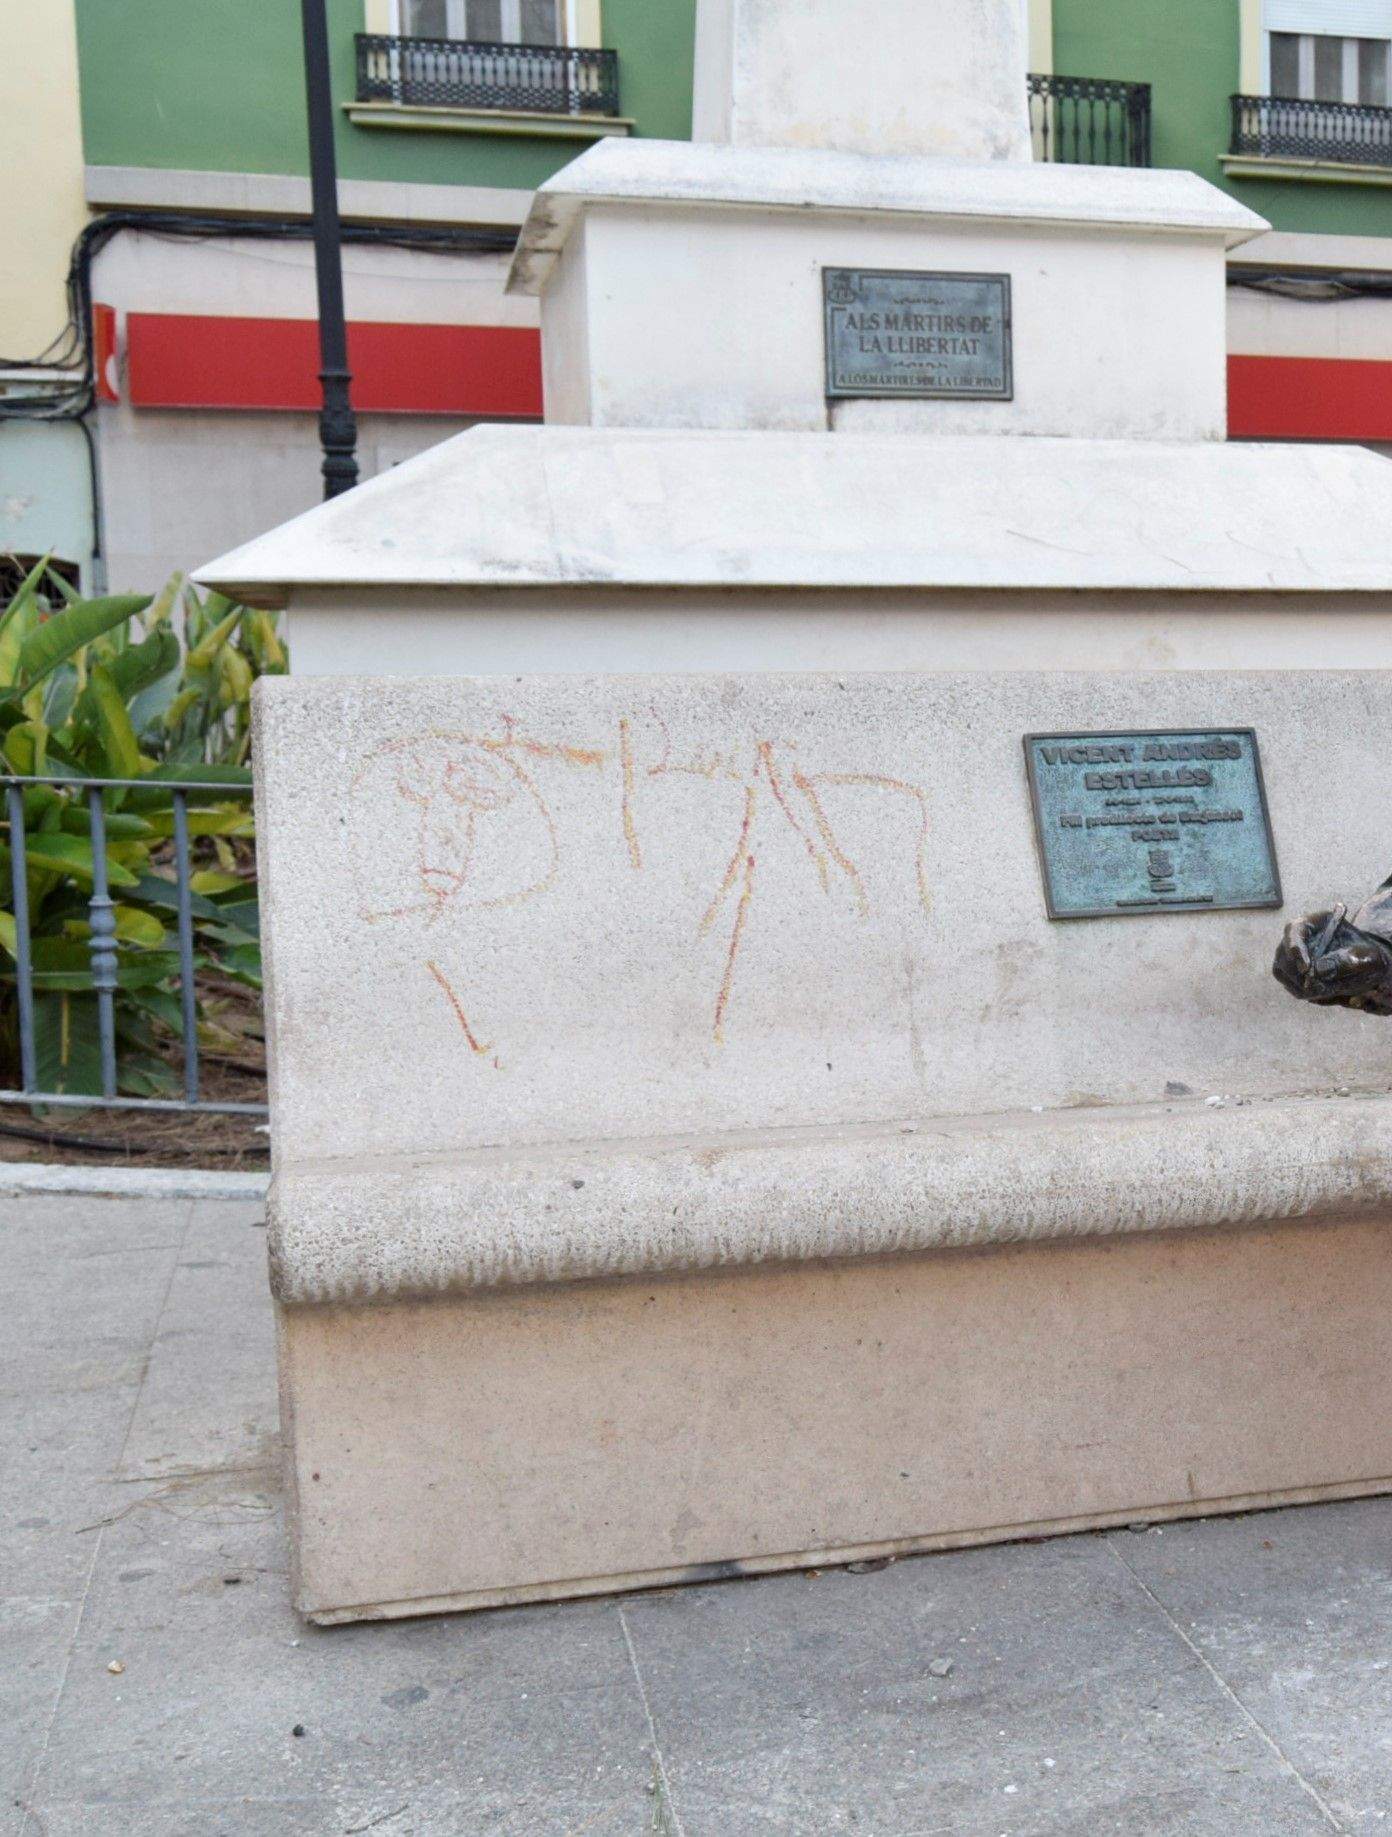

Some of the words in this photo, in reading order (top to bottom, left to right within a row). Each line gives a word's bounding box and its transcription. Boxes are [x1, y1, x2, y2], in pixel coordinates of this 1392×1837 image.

[846, 313, 880, 331] ALS
[967, 317, 993, 334] DE
[859, 336, 882, 353] LA
[887, 336, 981, 355] LLIBERTAT
[1040, 746, 1135, 765] VICENT
[1142, 738, 1242, 762] ANDRÉS
[1085, 767, 1211, 790] ESTELLÉS
